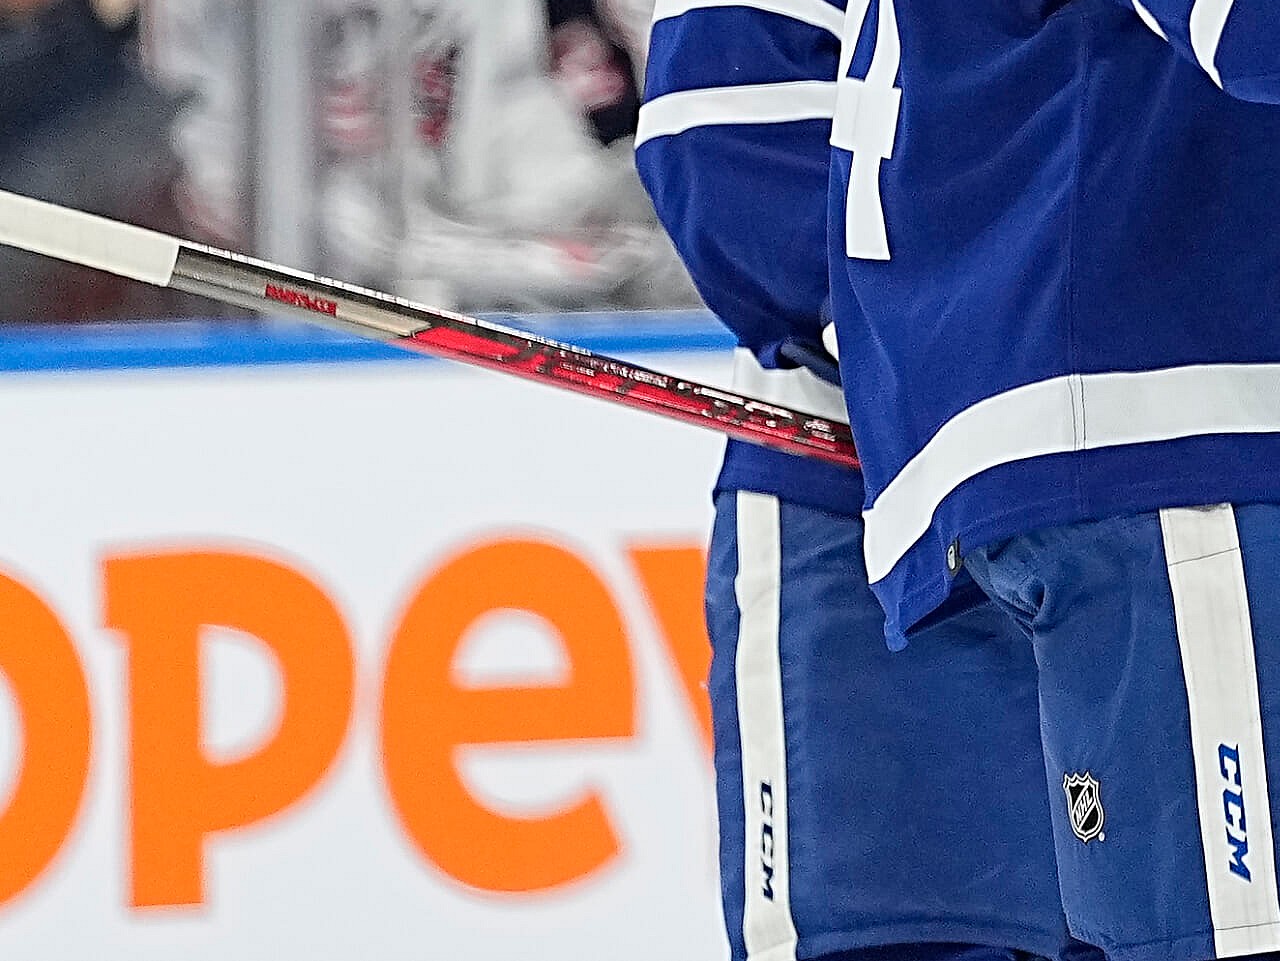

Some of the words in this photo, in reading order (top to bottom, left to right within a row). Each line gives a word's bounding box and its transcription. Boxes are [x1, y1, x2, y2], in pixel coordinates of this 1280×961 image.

[760, 782, 774, 902] CCM
[1075, 790, 1093, 827] NHL
[1217, 743, 1252, 883] CCM
